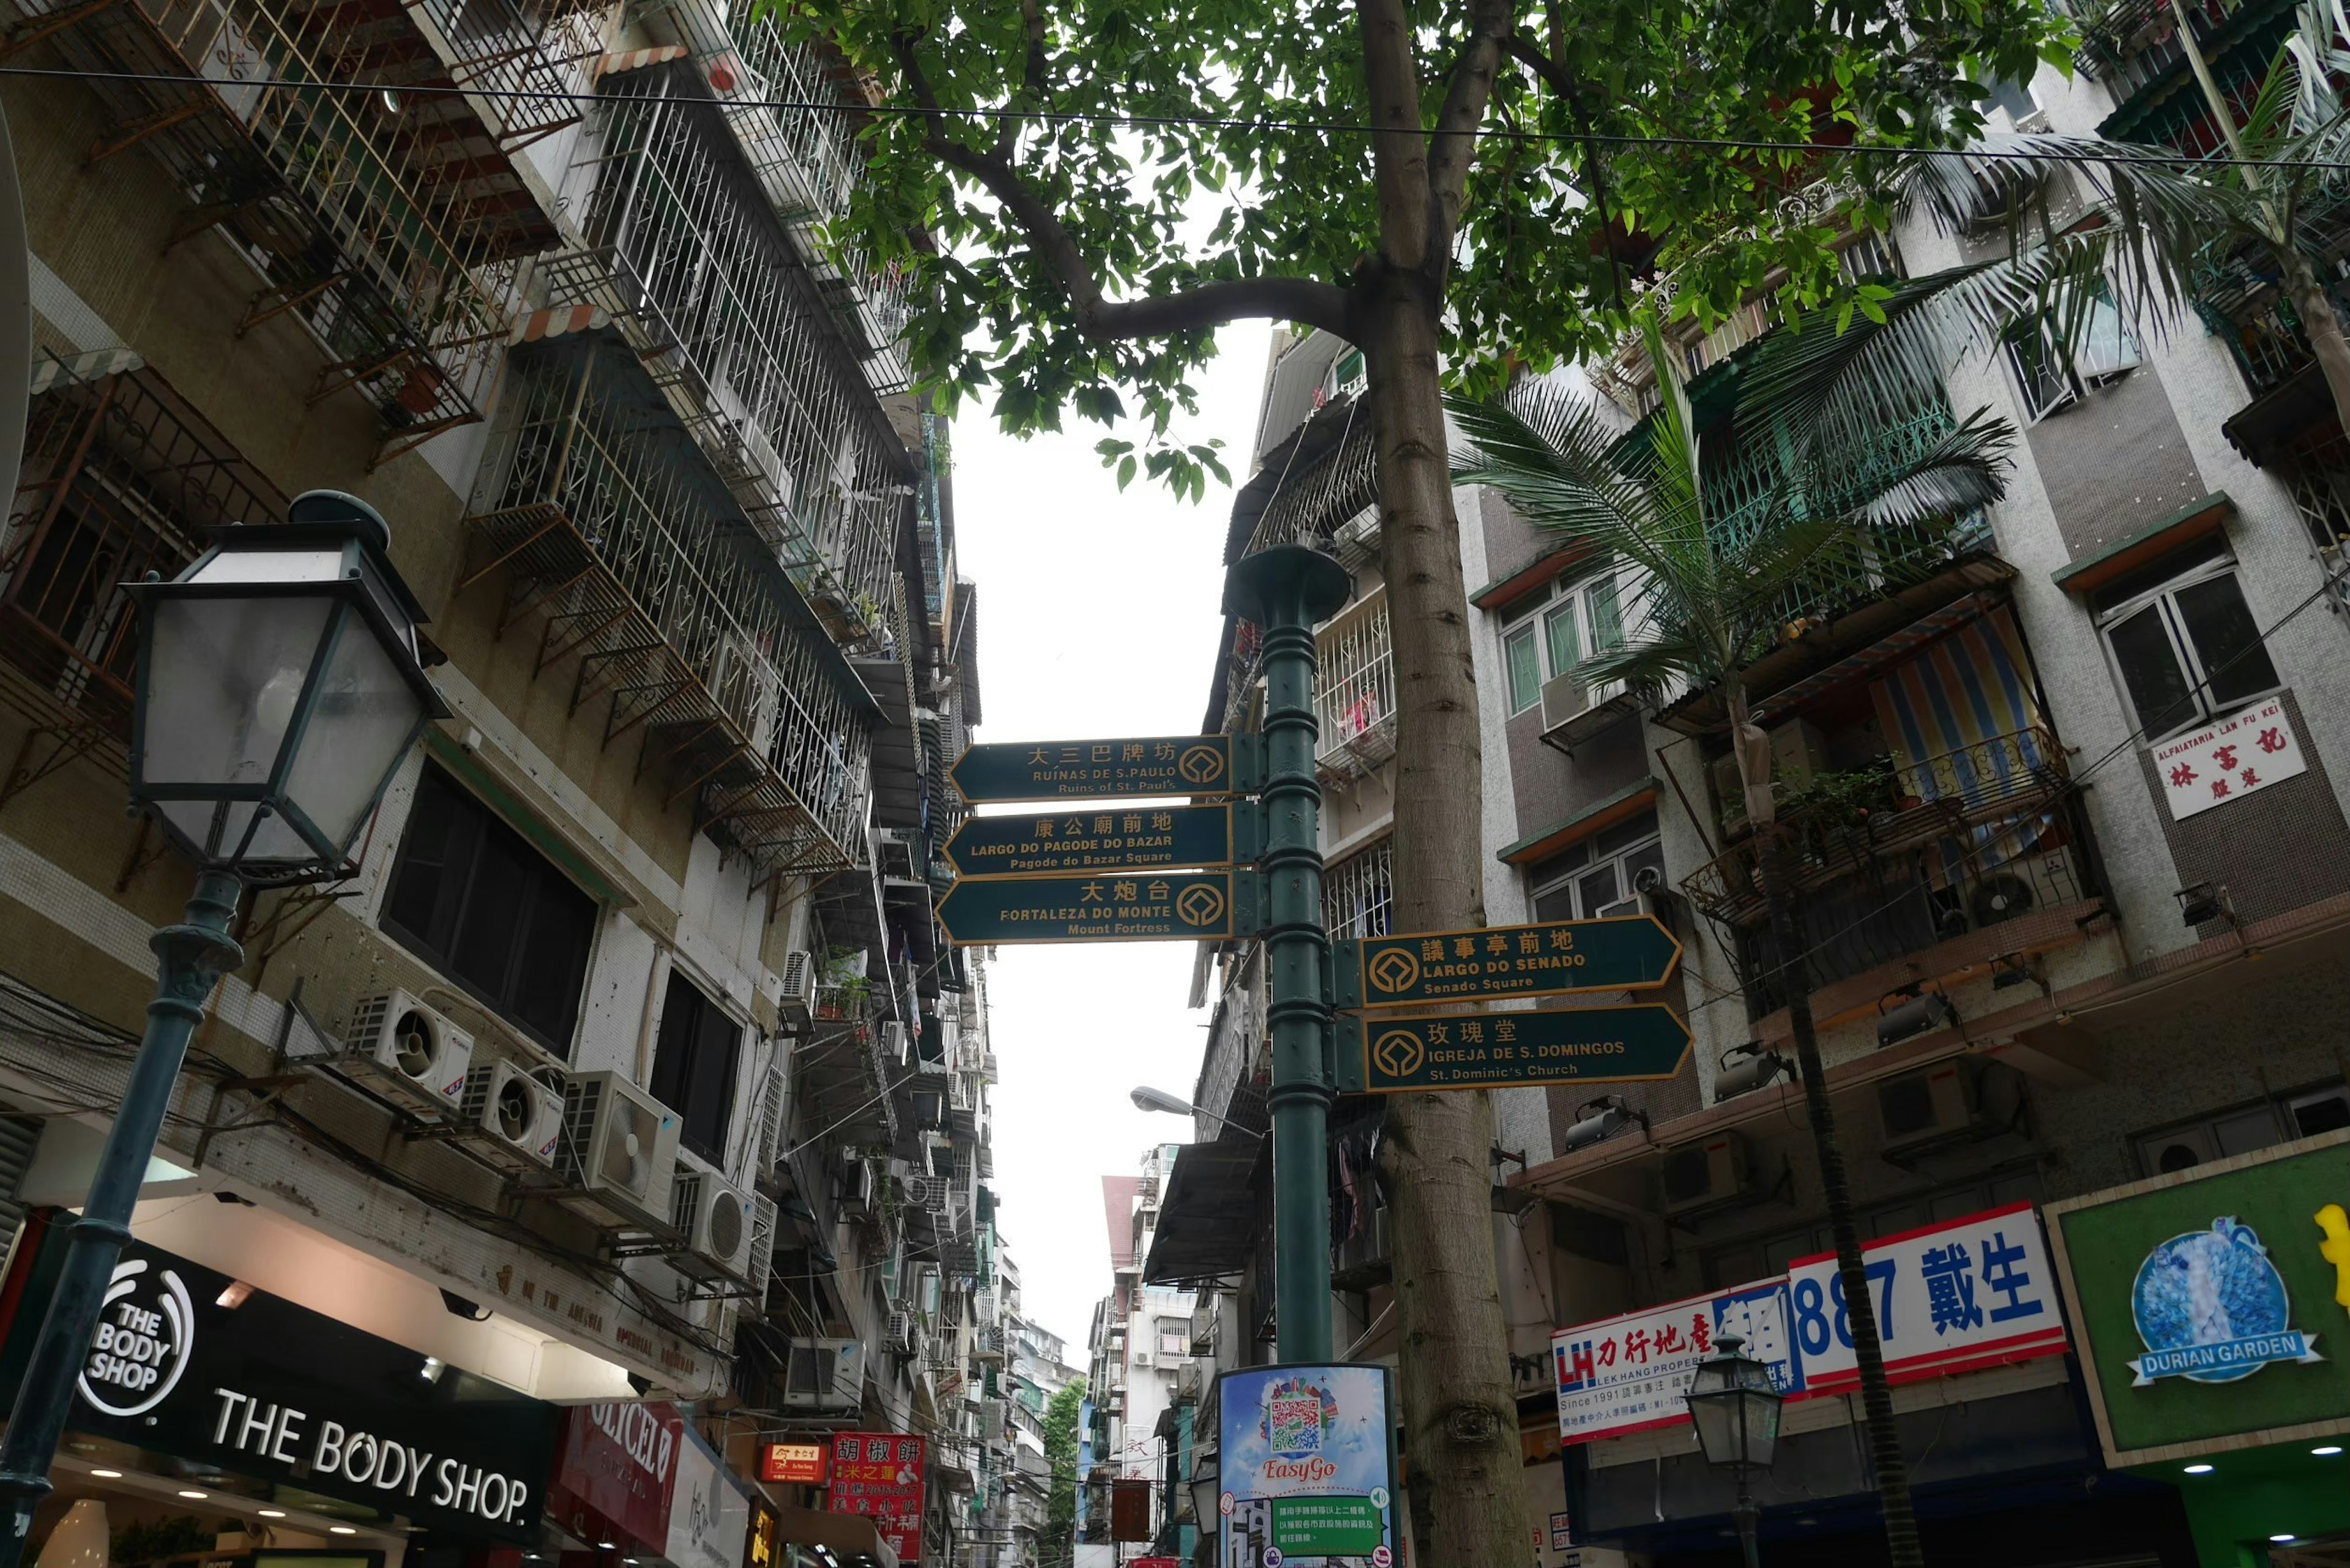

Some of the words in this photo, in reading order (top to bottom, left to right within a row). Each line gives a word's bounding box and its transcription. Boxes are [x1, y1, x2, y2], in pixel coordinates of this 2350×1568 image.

[2158, 731, 2214, 761] ALFAIATARIA
[2243, 714, 2256, 725] FU
[2261, 704, 2279, 718] KEI
[1028, 744, 1177, 766] 大三巴牌坊
[1033, 764, 1087, 781] RUÍNAS
[1092, 769, 1110, 779] DE
[1116, 767, 1176, 779] S.PAULO
[1059, 782, 1094, 793] Ruins
[1099, 782, 1111, 792] of
[1117, 781, 1133, 791] St.
[1138, 778, 1176, 791] Paul's
[1034, 812, 1173, 838] 康公廟前地
[971, 843, 1015, 856] LARGO
[1020, 842, 1039, 854] DO
[1044, 839, 1098, 852] PAGODE
[1103, 837, 1122, 849] DO
[1127, 835, 1172, 848] BAZAR
[1010, 857, 1058, 870] Pagode
[1063, 856, 1078, 866] do
[1084, 853, 1121, 865] Bazar
[1126, 851, 1172, 864] Square
[1081, 879, 1171, 903] 大炮台
[1000, 908, 1086, 921] FORTALEZA
[1092, 907, 1111, 919] DO
[1118, 905, 1171, 917] MONTE
[1068, 923, 1110, 935] Mount
[1114, 922, 1170, 934] Fortress
[1421, 929, 1574, 962] 議事亭前地
[1423, 963, 1480, 979] LARGO
[1486, 960, 1509, 974] DO
[1516, 954, 1586, 971] SENADO
[1424, 980, 1477, 995] Senado
[1483, 977, 1534, 992] Square
[1427, 1019, 1516, 1045] 玫瑰堂
[1428, 1048, 1486, 1062] IGREJA
[1493, 1047, 1515, 1060] DE
[1520, 1045, 1534, 1058] S.
[1538, 1042, 1625, 1058] DOMINGOS
[1430, 1069, 1449, 1081] St.
[1452, 1067, 1522, 1080] Dominic's
[1527, 1063, 1578, 1076] Church
[1920, 1230, 2044, 1337] 戴生
[117, 1302, 162, 1336] THE
[92, 1321, 172, 1367] BODY
[1597, 1313, 1712, 1367] 力行地產
[2145, 1345, 2215, 1374] DURIAN
[2217, 1335, 2297, 1361] GARDEN
[87, 1354, 158, 1392] SHOP
[1597, 1375, 1618, 1386] LEK
[1621, 1367, 1651, 1381] HANG
[1561, 1396, 1591, 1411] Since
[1594, 1389, 1619, 1405] 1991
[214, 1387, 307, 1464] THE
[313, 1420, 433, 1498] BODY
[837, 1438, 921, 1462] 胡椒餅
[845, 1464, 897, 1480] 米之蓮
[1263, 1457, 1337, 1484] EasyGo
[832, 1498, 916, 1514] 美食小吃
